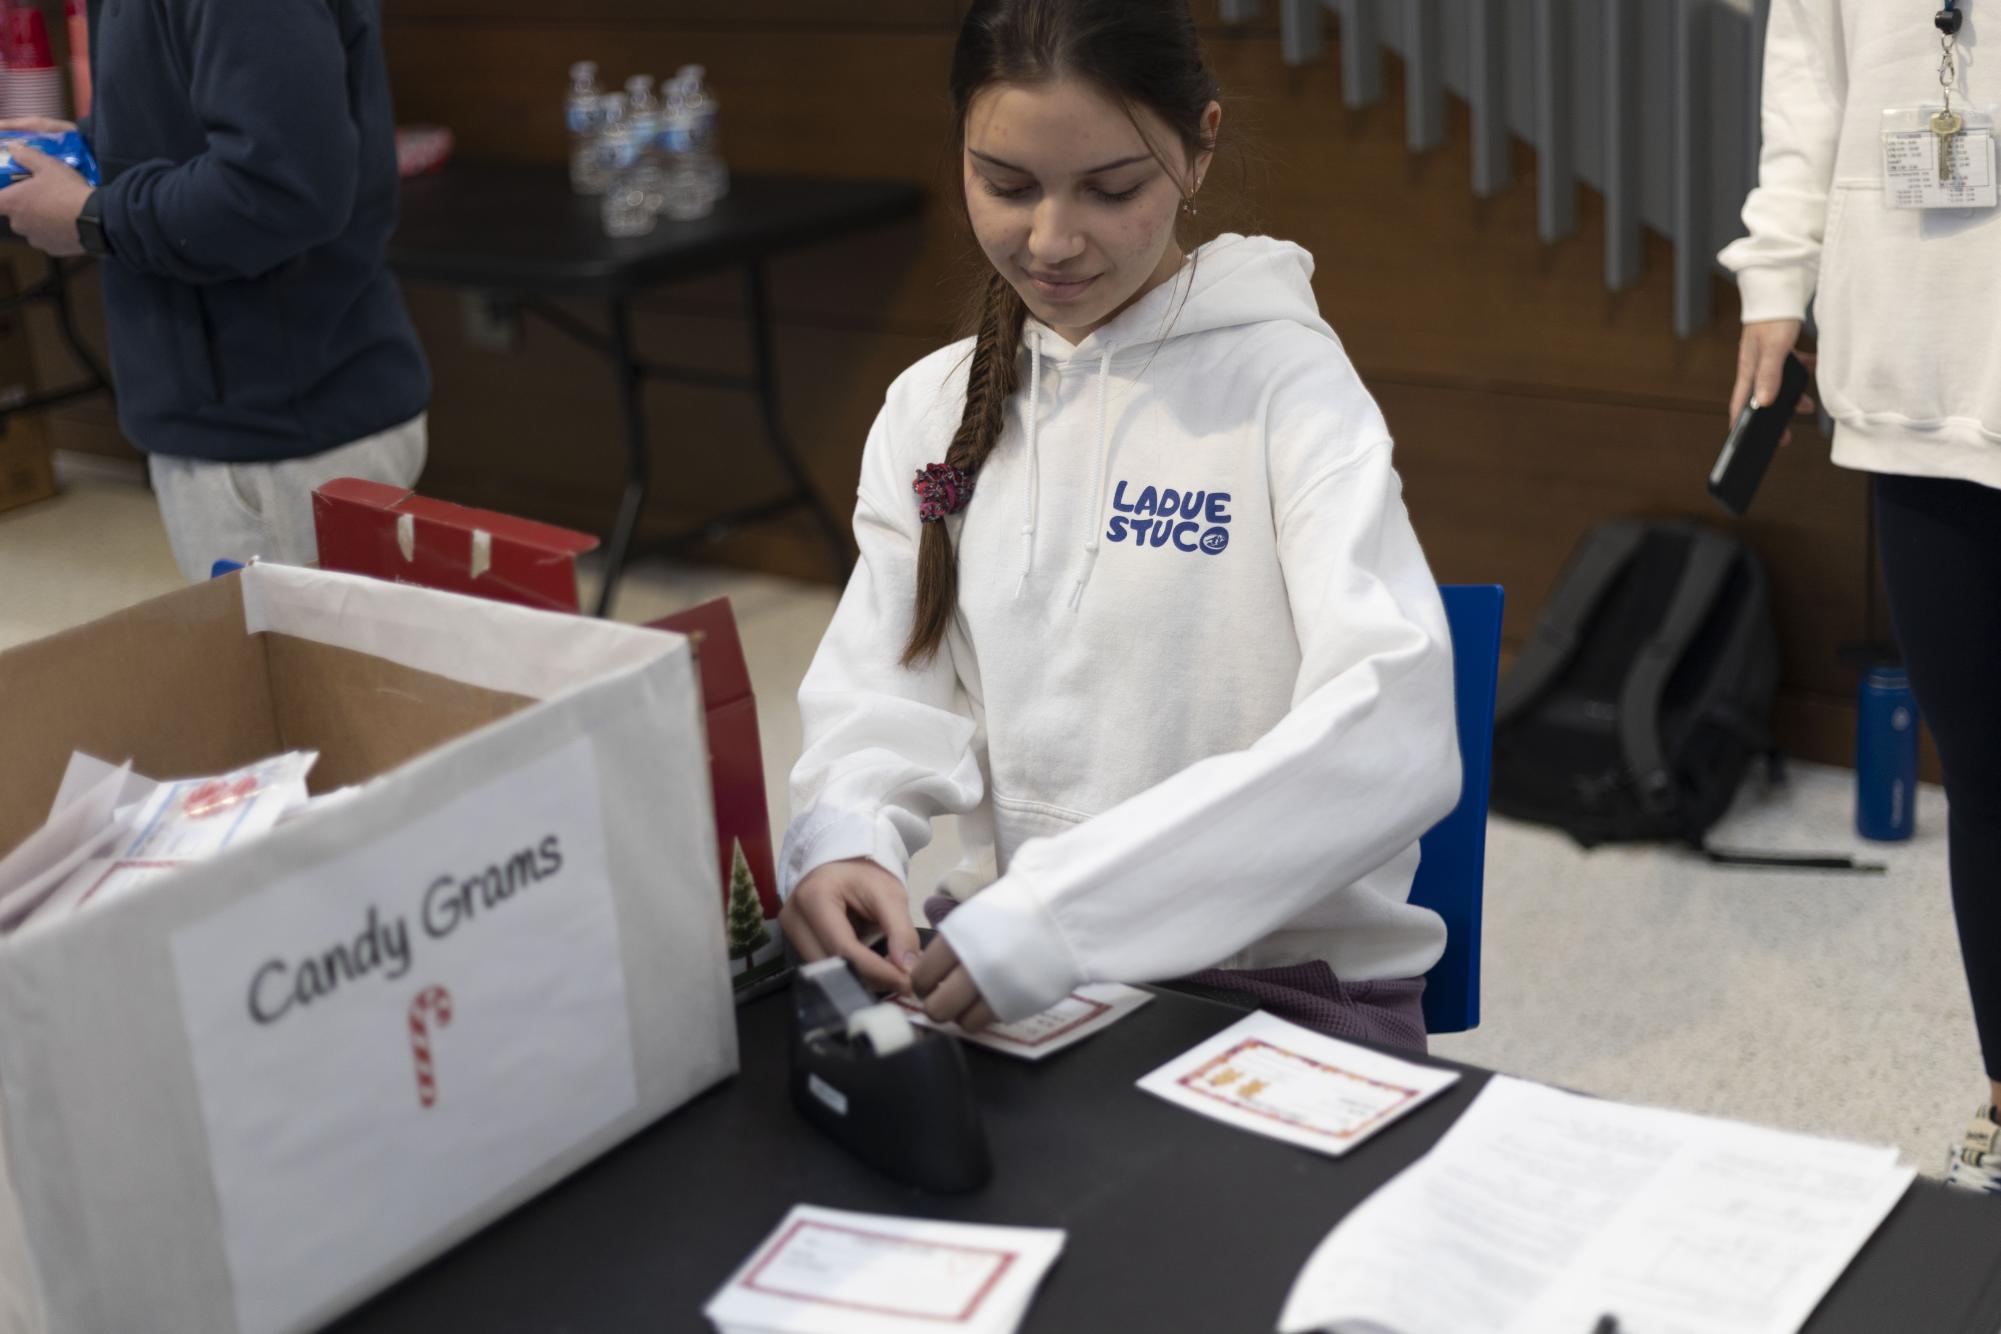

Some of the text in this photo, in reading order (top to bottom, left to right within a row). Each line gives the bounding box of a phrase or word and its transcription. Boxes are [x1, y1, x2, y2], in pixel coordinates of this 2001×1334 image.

[1113, 480, 1231, 523] LADUE
[1106, 516, 1229, 555] STUCO
[248, 835, 563, 1024] Candy Grams
